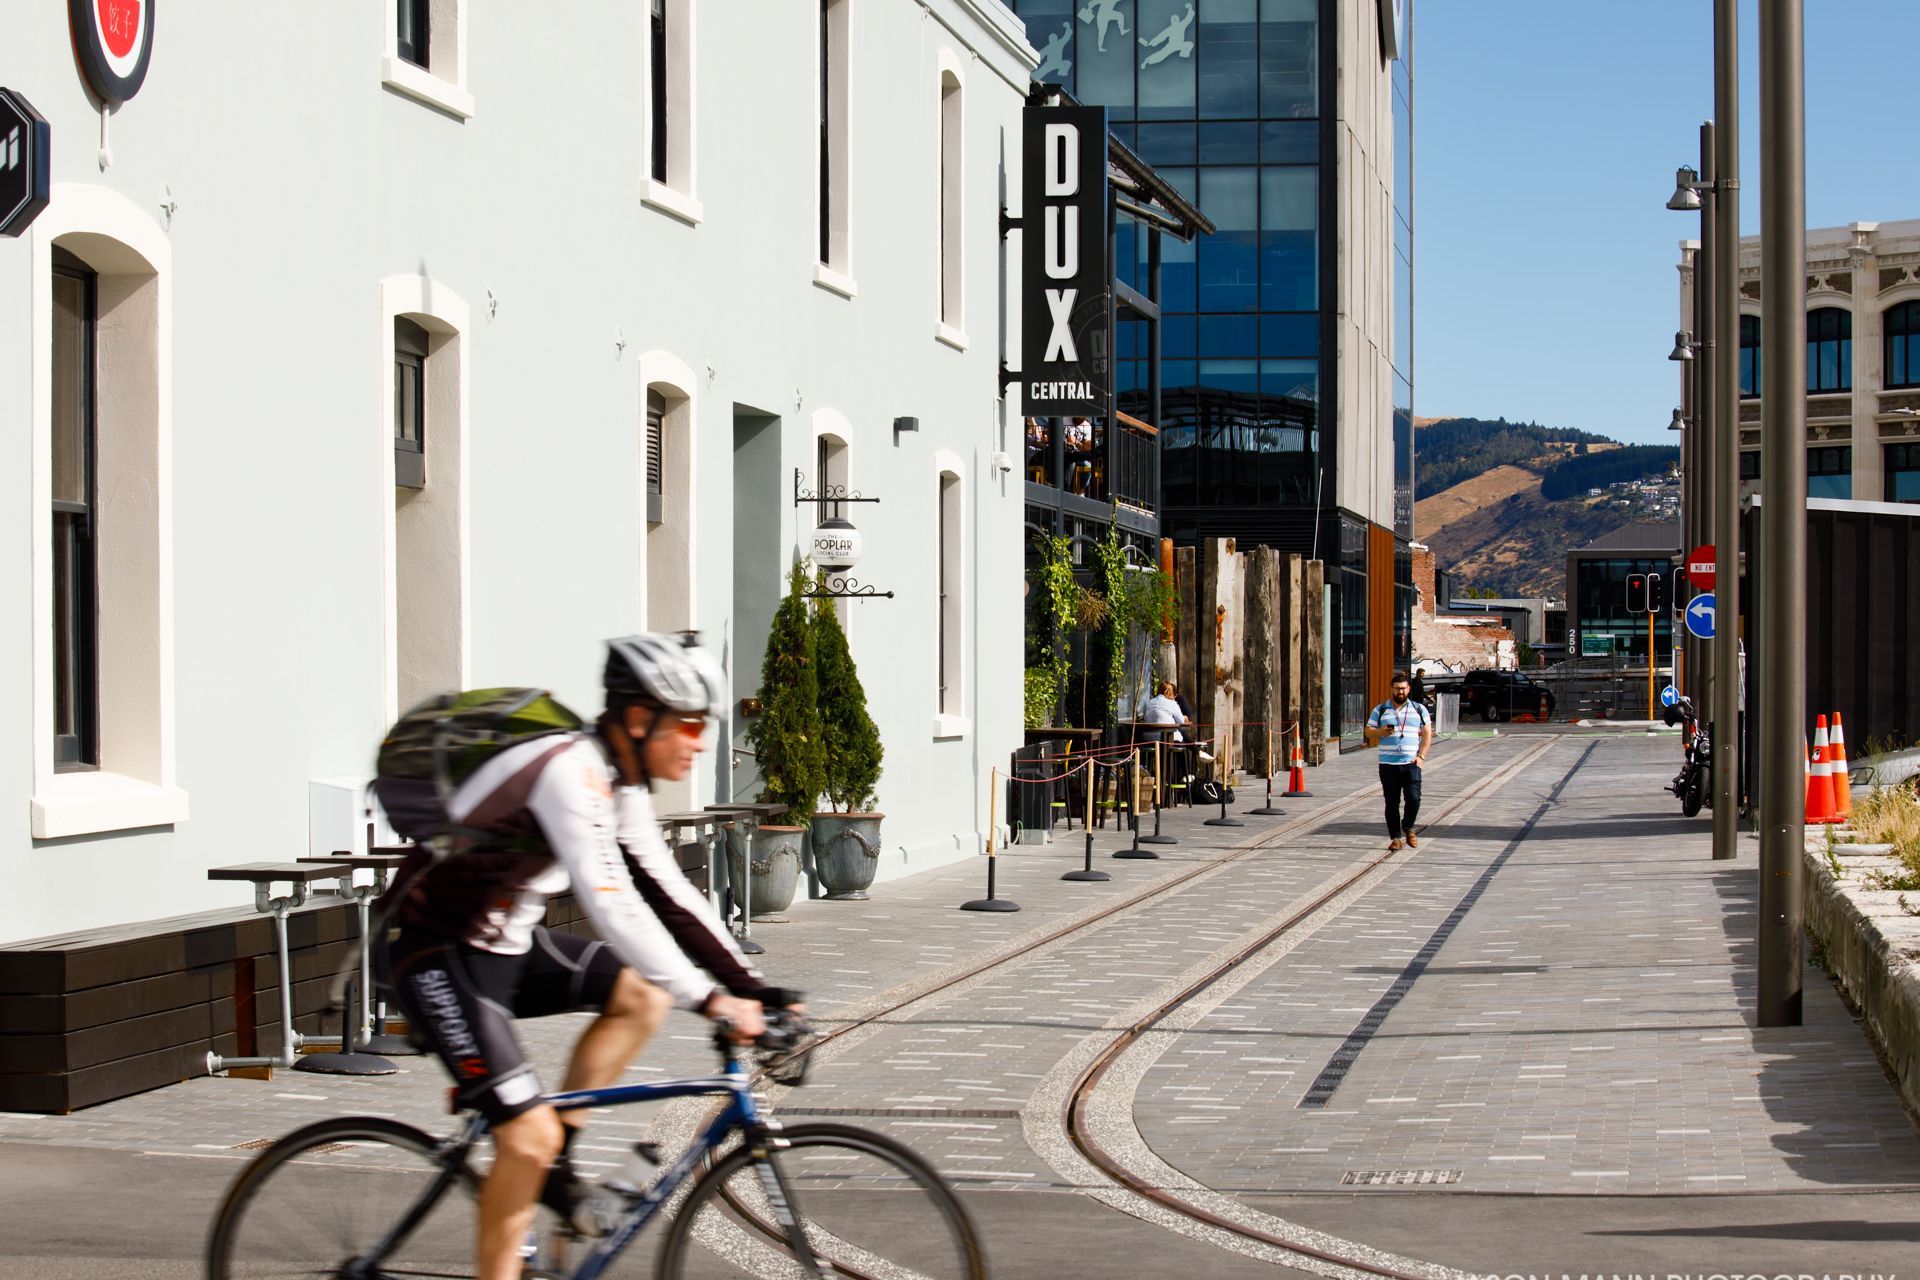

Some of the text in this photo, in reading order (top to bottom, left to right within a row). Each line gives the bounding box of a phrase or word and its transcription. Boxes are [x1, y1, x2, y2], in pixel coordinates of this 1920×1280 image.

[1044, 123, 1079, 362] DUX
[1031, 382, 1094, 400] CENTRAL
[815, 539, 853, 550] POPLAR
[413, 969, 481, 1056] SUPPORT
